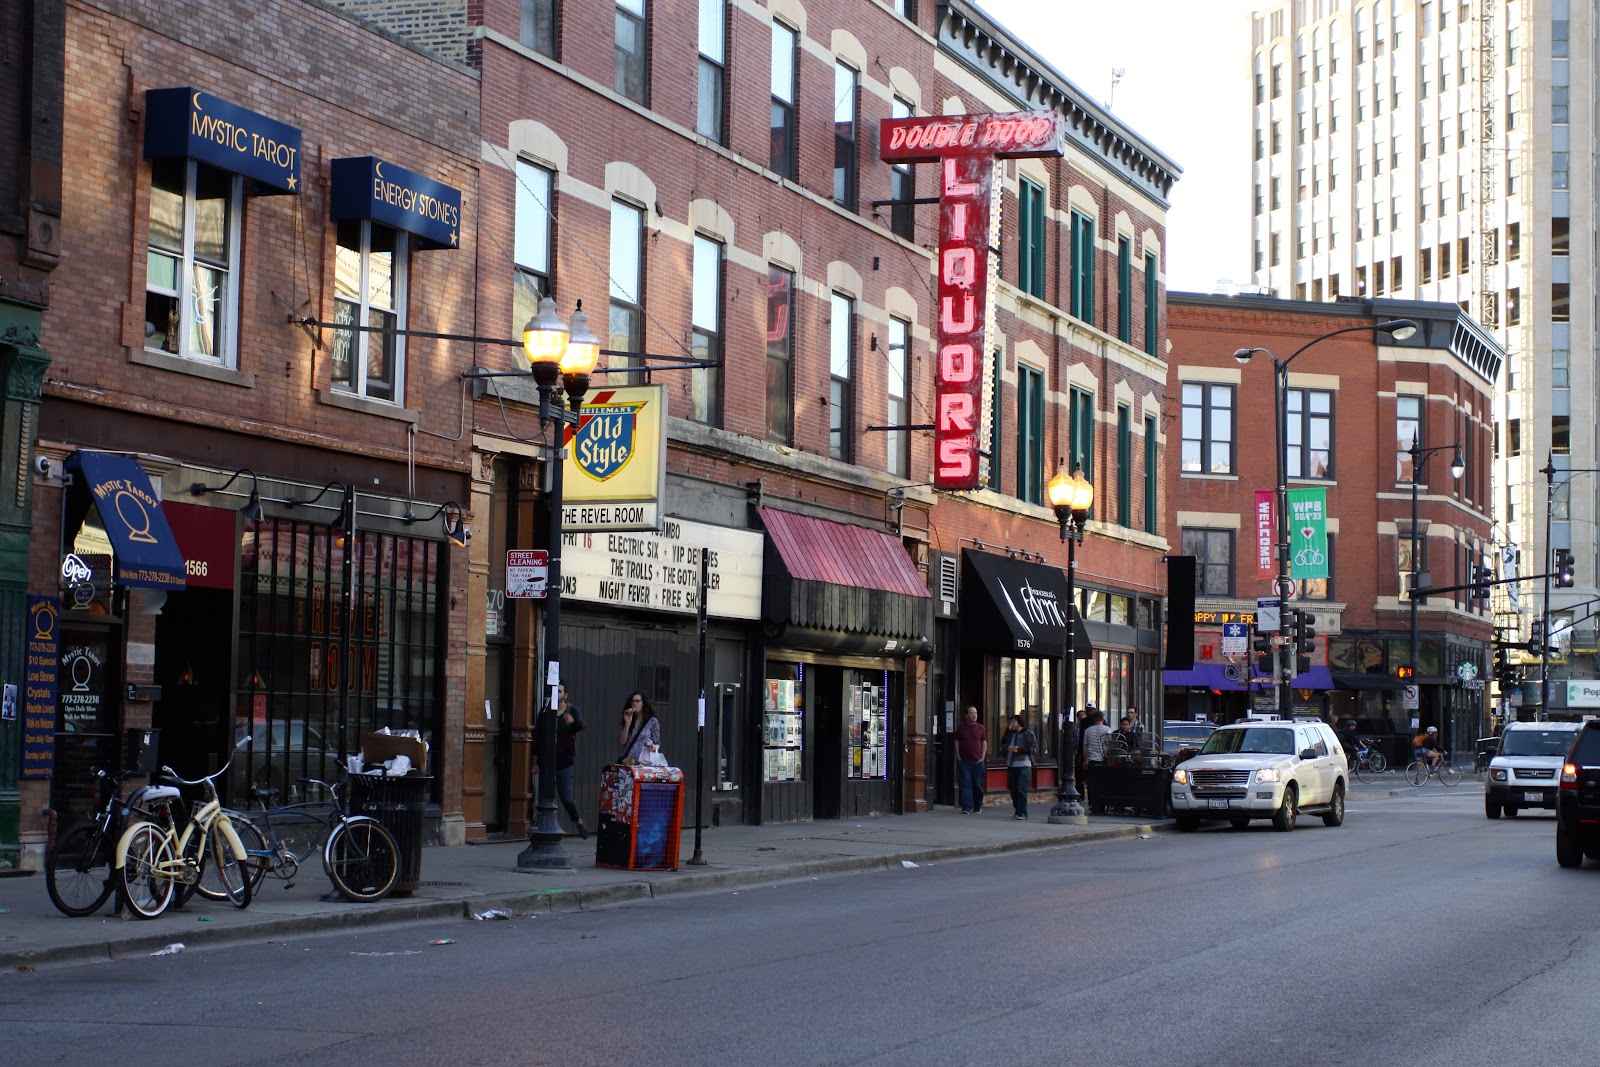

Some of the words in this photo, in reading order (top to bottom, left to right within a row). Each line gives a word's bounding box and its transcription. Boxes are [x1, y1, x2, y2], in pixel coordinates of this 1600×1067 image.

[192, 111, 248, 152] MYSTIC
[252, 132, 297, 171] TAROT
[889, 122, 978, 150] DOUBLE
[983, 118, 1050, 145] DOOR
[374, 177, 418, 212] ENERGY
[418, 193, 458, 228] STONE'S
[939, 158, 977, 478] LIQUORS
[579, 406, 632, 414] HEILEMAN'S
[590, 415, 623, 441] Old
[579, 438, 627, 474] Style
[580, 507, 611, 524] REVEL
[614, 507, 644, 524] ROOM
[1292, 501, 1322, 513] WPB
[583, 532, 593, 550] 16
[1258, 501, 1271, 569] WELCOME!
[608, 533, 645, 557] ELECTRIC
[647, 541, 659, 560] SIX
[673, 545, 685, 563] YIP
[62, 553, 92, 588] Open
[184, 559, 208, 577] 1566
[610, 558, 624, 577] THE
[625, 560, 653, 581] TROLLS
[662, 565, 676, 584] THE
[598, 580, 626, 600] NIGHT
[627, 584, 651, 604] FEVER
[661, 588, 682, 608] FREE
[685, 591, 701, 610] SHO
[312, 588, 388, 637] REVEL
[1017, 639, 1031, 649] 1576
[28, 655, 39, 665] $10
[38, 656, 57, 667] Special
[1407, 667, 1412, 677] 4
[27, 670, 39, 682] Love
[39, 670, 55, 682] Stones
[26, 686, 51, 700] Crystals
[61, 694, 100, 704] 773-278-2238
[64, 705, 76, 713] Open
